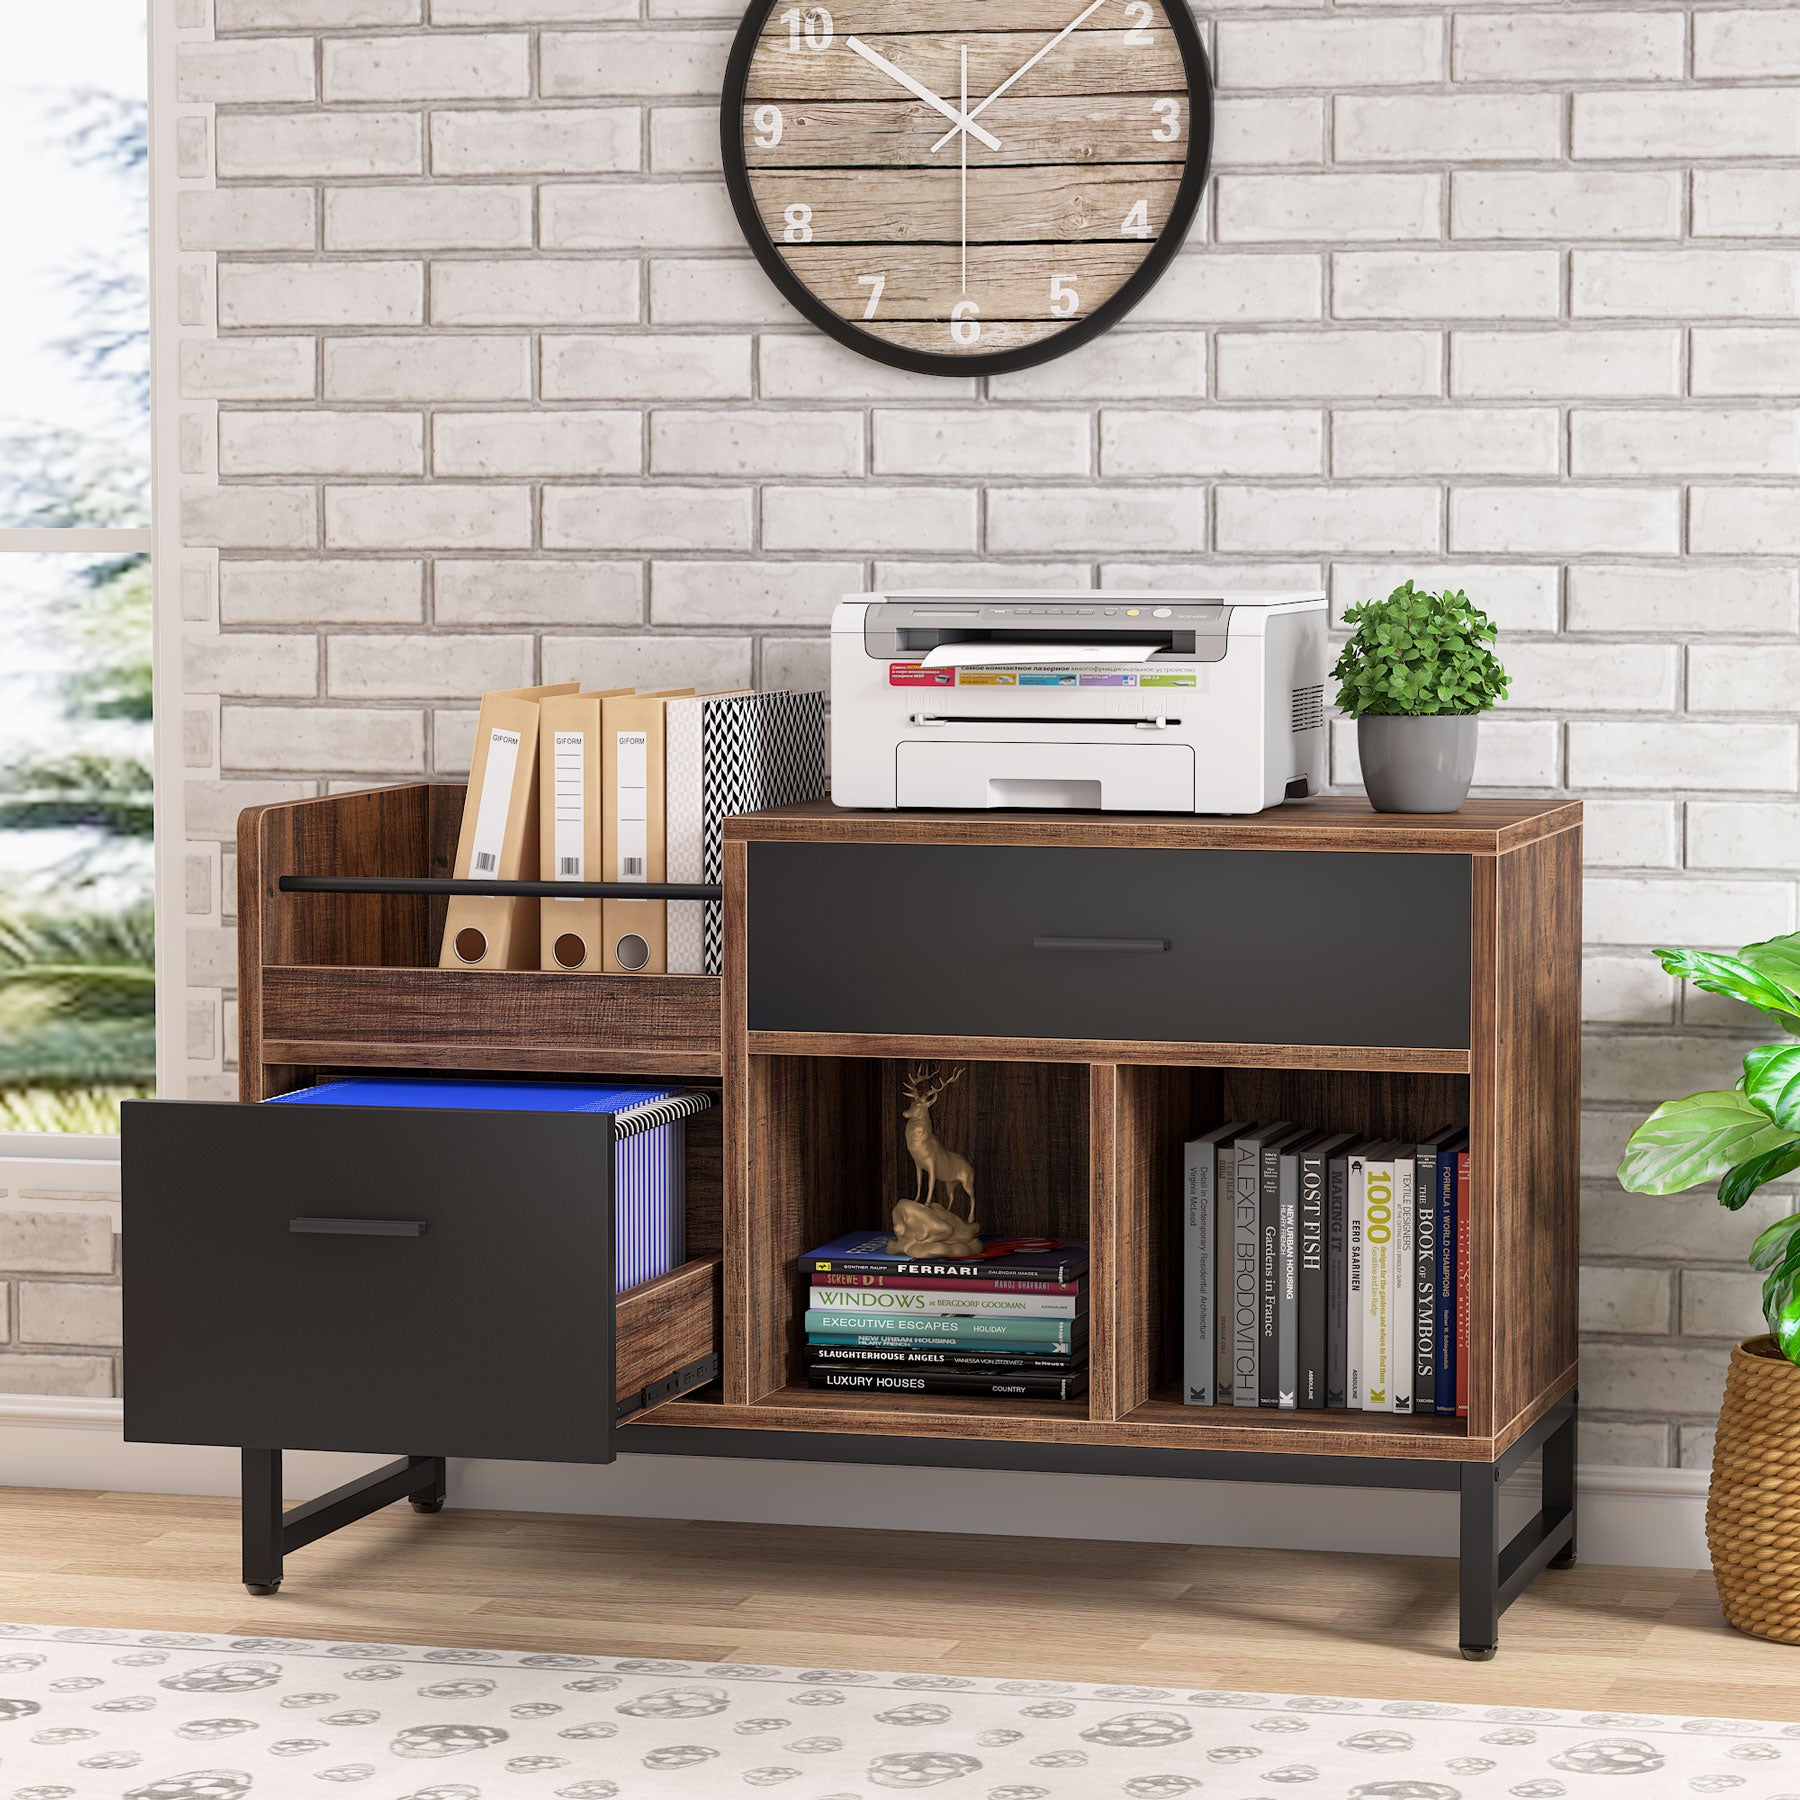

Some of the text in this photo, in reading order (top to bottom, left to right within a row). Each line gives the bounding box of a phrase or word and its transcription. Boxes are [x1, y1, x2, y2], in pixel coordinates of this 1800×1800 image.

[780, 8, 834, 52] 10
[1123, 2, 1155, 45] 2
[753, 104, 784, 148] 9
[1152, 98, 1182, 142] 3
[783, 203, 814, 244] 8
[1120, 200, 1153, 240] 4
[858, 276, 886, 319] 7
[1050, 275, 1080, 317] 5
[950, 301, 980, 345] 6
[492, 734, 518, 744] GIFORM
[1189, 1167, 1197, 1194] Virginia
[1332, 1170, 1342, 1232] MAKING
[1199, 1198, 1208, 1251] Contemporary
[1303, 1158, 1321, 1270] LOST FISH
[1367, 1171, 1392, 1244] 1000
[1403, 1173, 1411, 1251] TEXTILE DESIGNERS
[1332, 1237, 1342, 1252] IT
[1352, 1220, 1360, 1291] EERO SAARINEN
[1419, 1208, 1434, 1262] BOOK
[897, 1264, 978, 1276] FERRARI
[1200, 1253, 1208, 1294] Residential
[1236, 1146, 1255, 1389] ALEXEY BRODOVITCH
[1265, 1226, 1277, 1337] Gardens in France
[1419, 1266, 1426, 1278] OF
[817, 1292, 925, 1308] WINDOWS
[1379, 1291, 1387, 1315] gardens
[822, 1318, 959, 1331] EXECUTIVE ESCAPES
[1418, 1282, 1434, 1376] SYMBOLS
[818, 1350, 944, 1362] SLAUGHTERHOUSE ANGELS
[826, 1375, 925, 1388] LUXURY HOUSES
